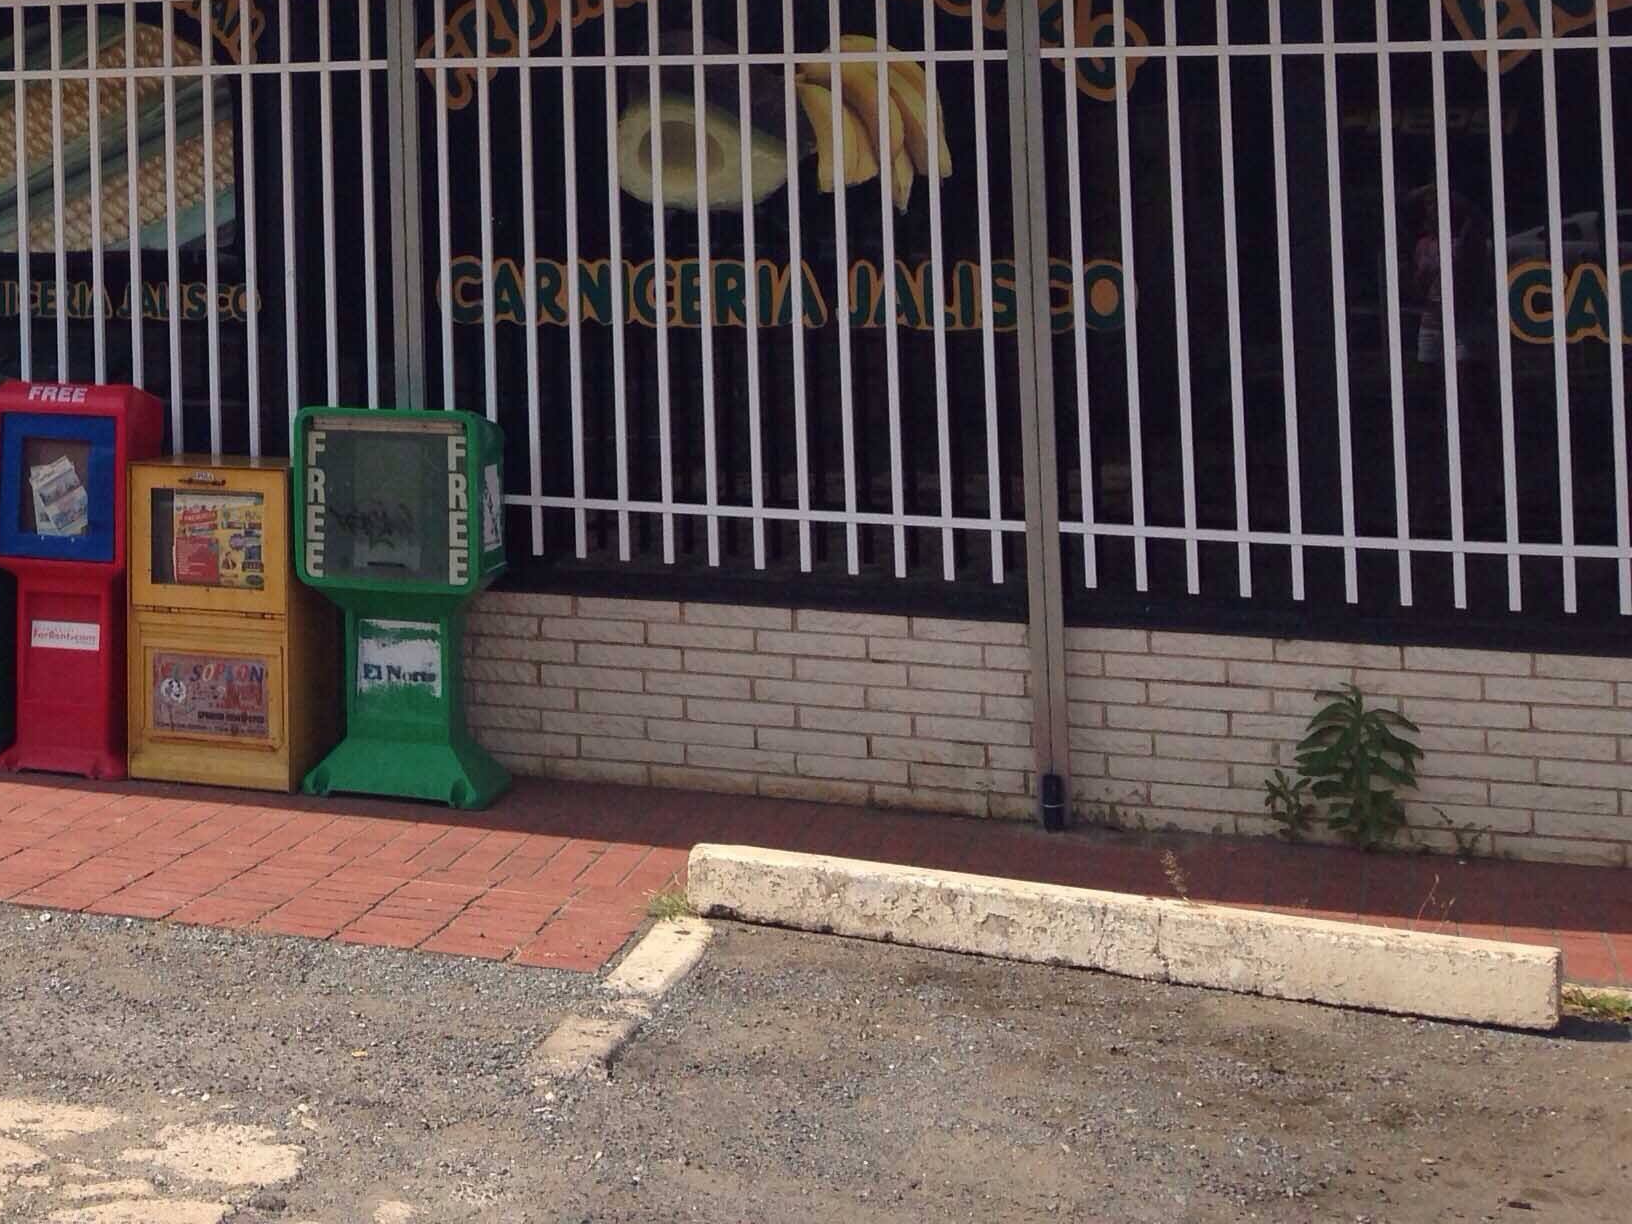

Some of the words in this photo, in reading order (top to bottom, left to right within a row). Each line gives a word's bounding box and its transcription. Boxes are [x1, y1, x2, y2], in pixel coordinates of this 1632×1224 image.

[436, 256, 828, 328] CARNICERIA
[1506, 262, 1632, 344] CA
[27, 385, 89, 404] FREE
[306, 431, 327, 578] FREE
[447, 435, 469, 586] FREE
[363, 663, 383, 681] El
